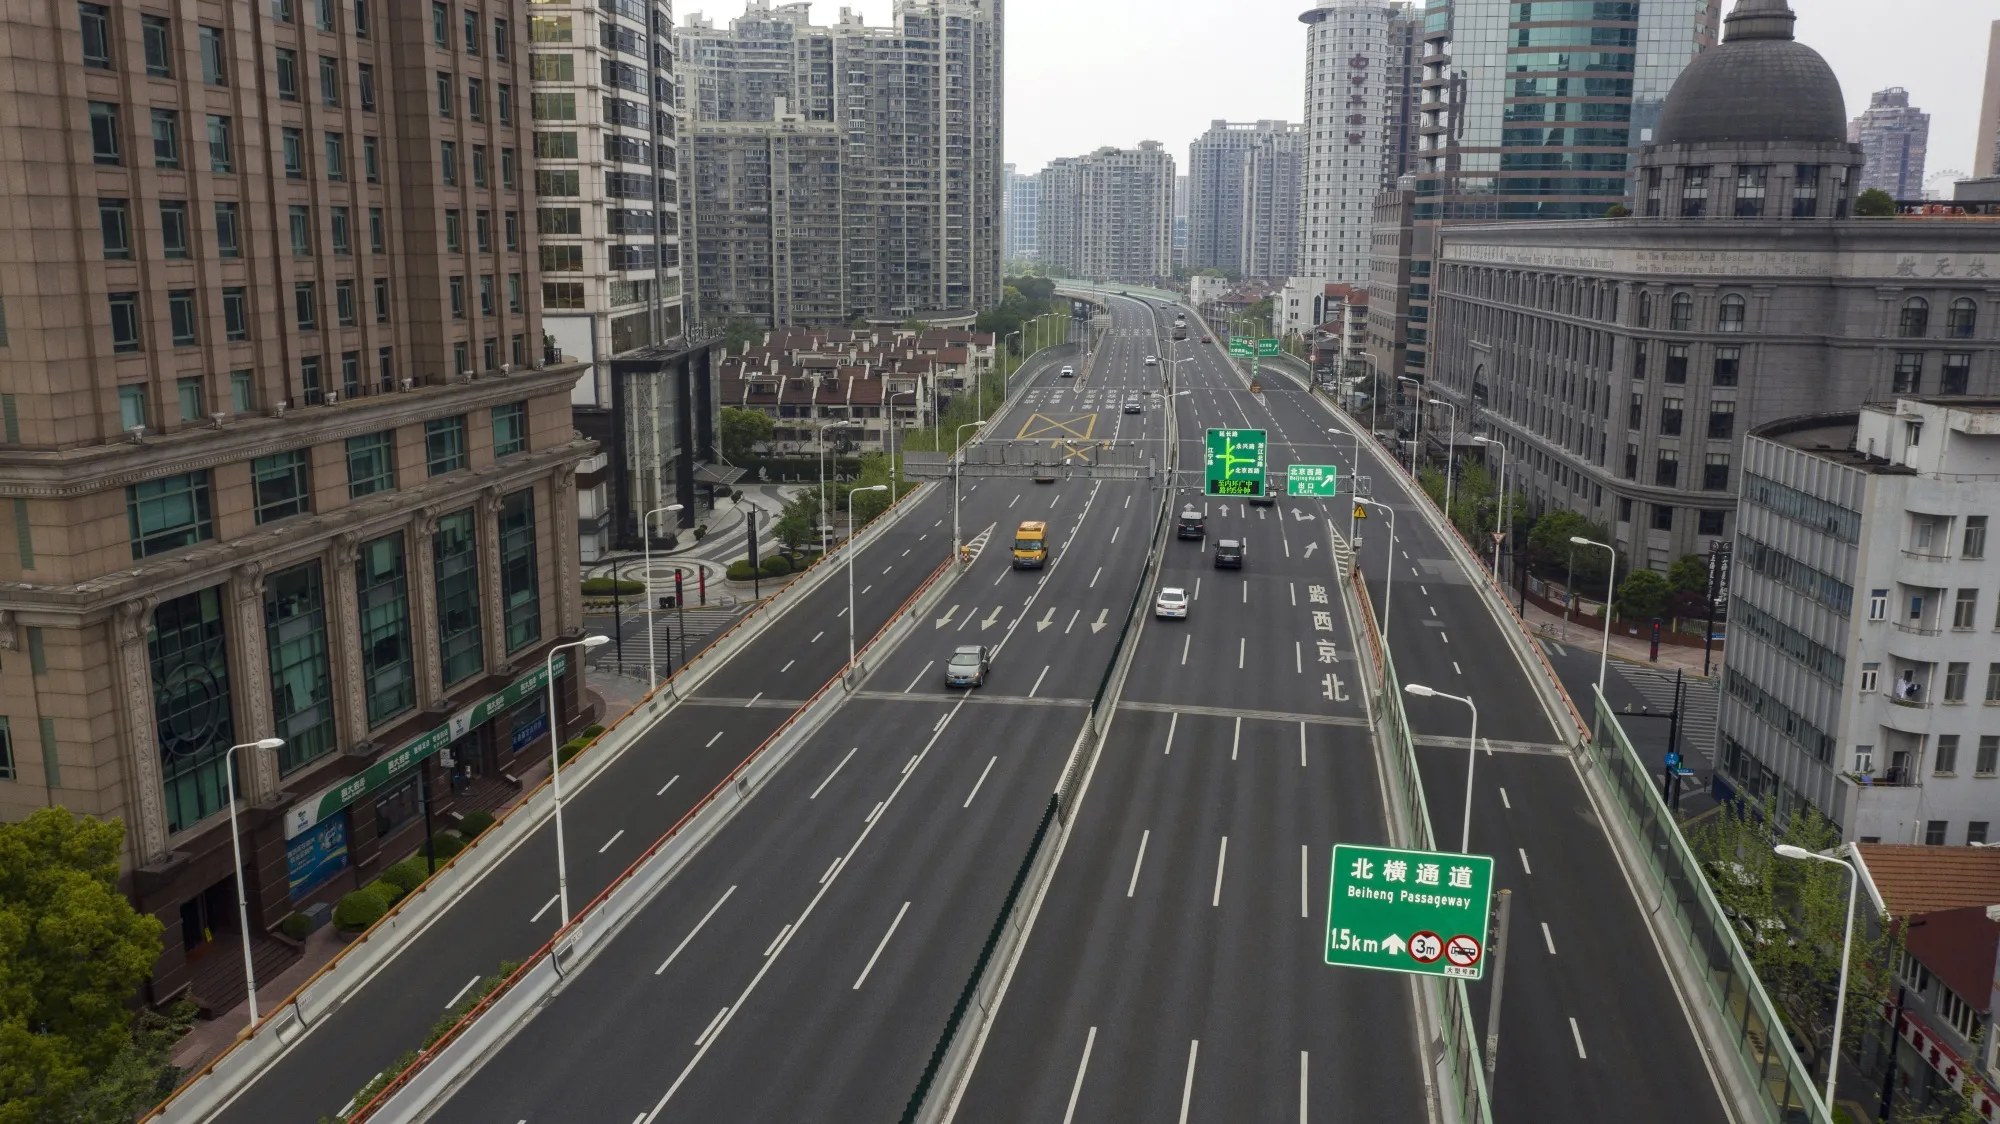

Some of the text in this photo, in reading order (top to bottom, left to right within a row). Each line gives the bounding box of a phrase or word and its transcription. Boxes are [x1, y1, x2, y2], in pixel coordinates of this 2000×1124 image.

[1290, 468, 1323, 476] 北京西路
[1351, 857, 1473, 889] 北横通道
[1347, 885, 1471, 910] Beiheng Passageway
[1331, 927, 1378, 953] 1.5km
[1415, 939, 1436, 956] 3m
